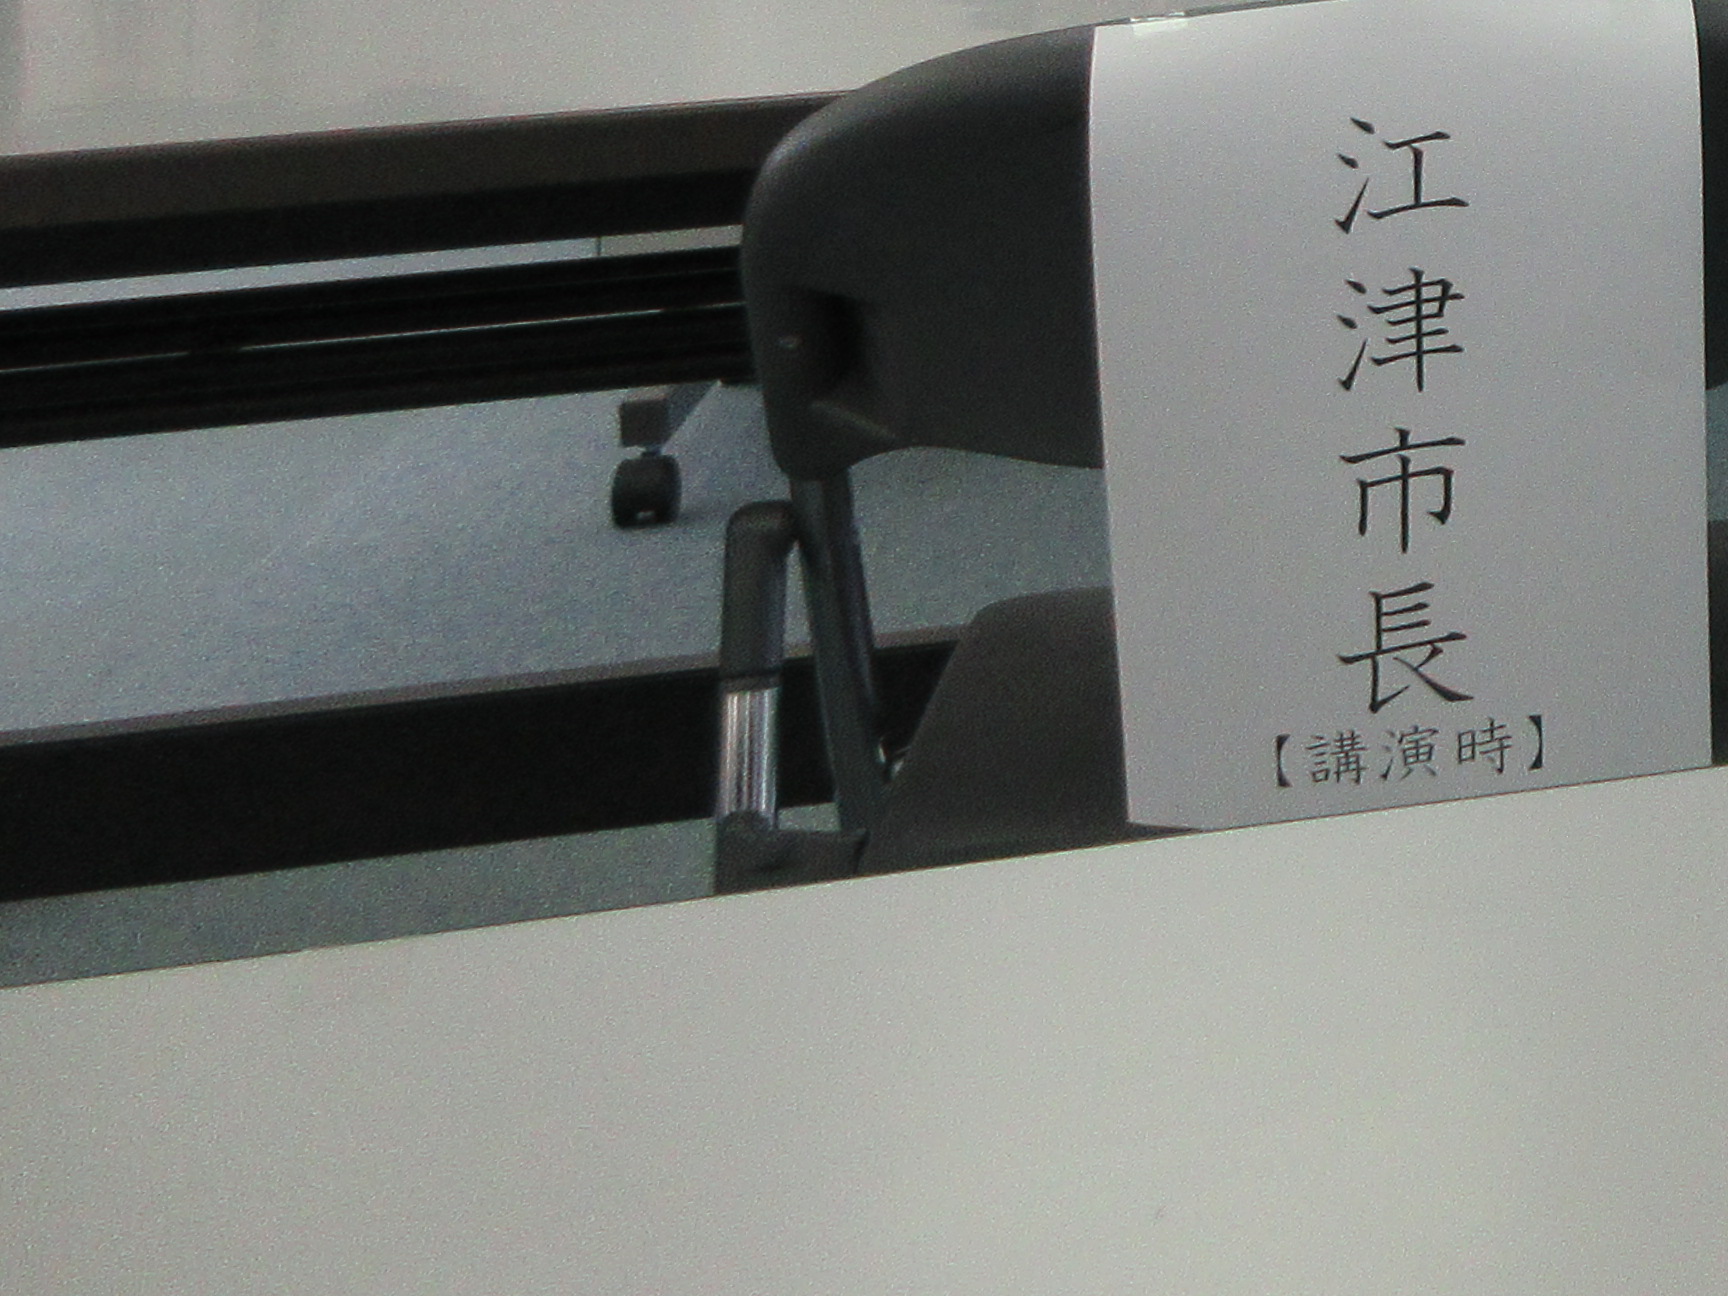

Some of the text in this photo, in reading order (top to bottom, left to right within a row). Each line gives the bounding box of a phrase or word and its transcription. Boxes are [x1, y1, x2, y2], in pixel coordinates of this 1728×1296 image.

[1334, 116, 1475, 715] 江津市長
[1274, 712, 1545, 791] 【講演時】
